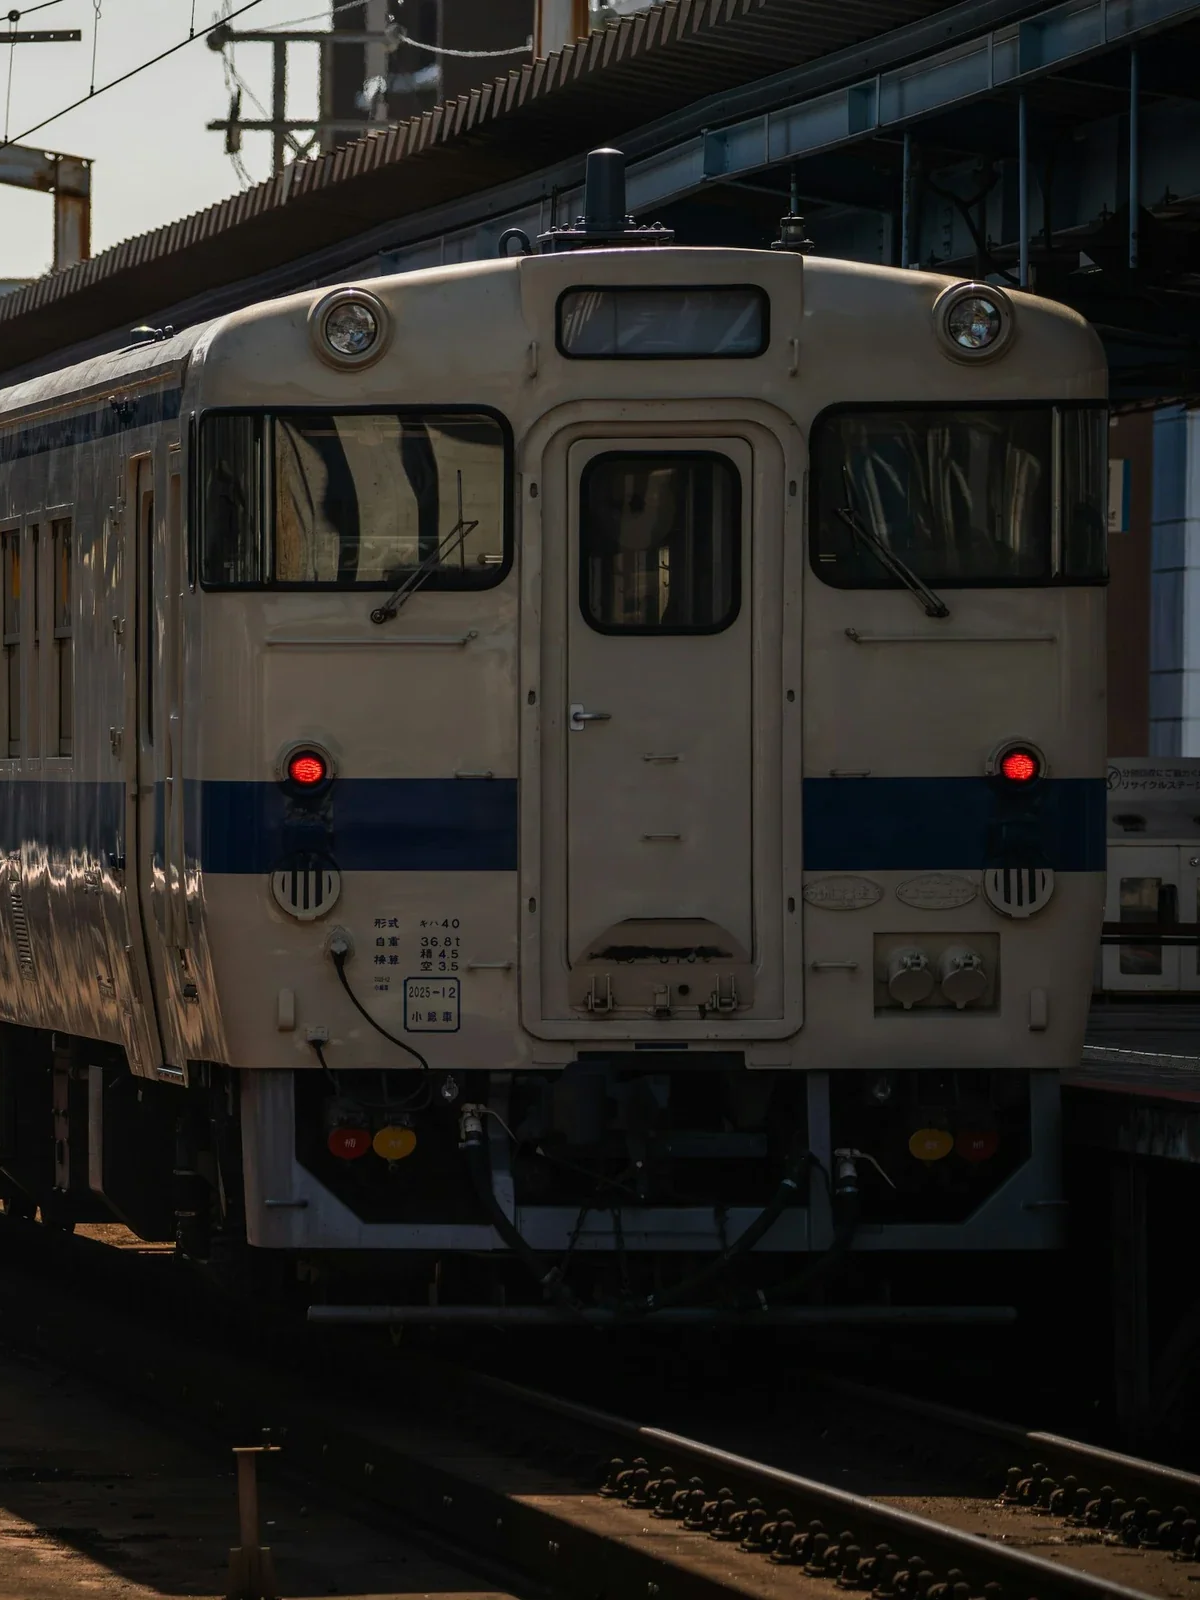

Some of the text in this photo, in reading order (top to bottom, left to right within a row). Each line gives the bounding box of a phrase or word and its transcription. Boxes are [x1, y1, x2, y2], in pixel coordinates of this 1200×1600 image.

[374, 918, 400, 929] 形式
[375, 936, 400, 947] 自重
[438, 949, 459, 959] 4.5
[420, 961, 459, 972] 空 3.5
[408, 986, 456, 999] 2025-12
